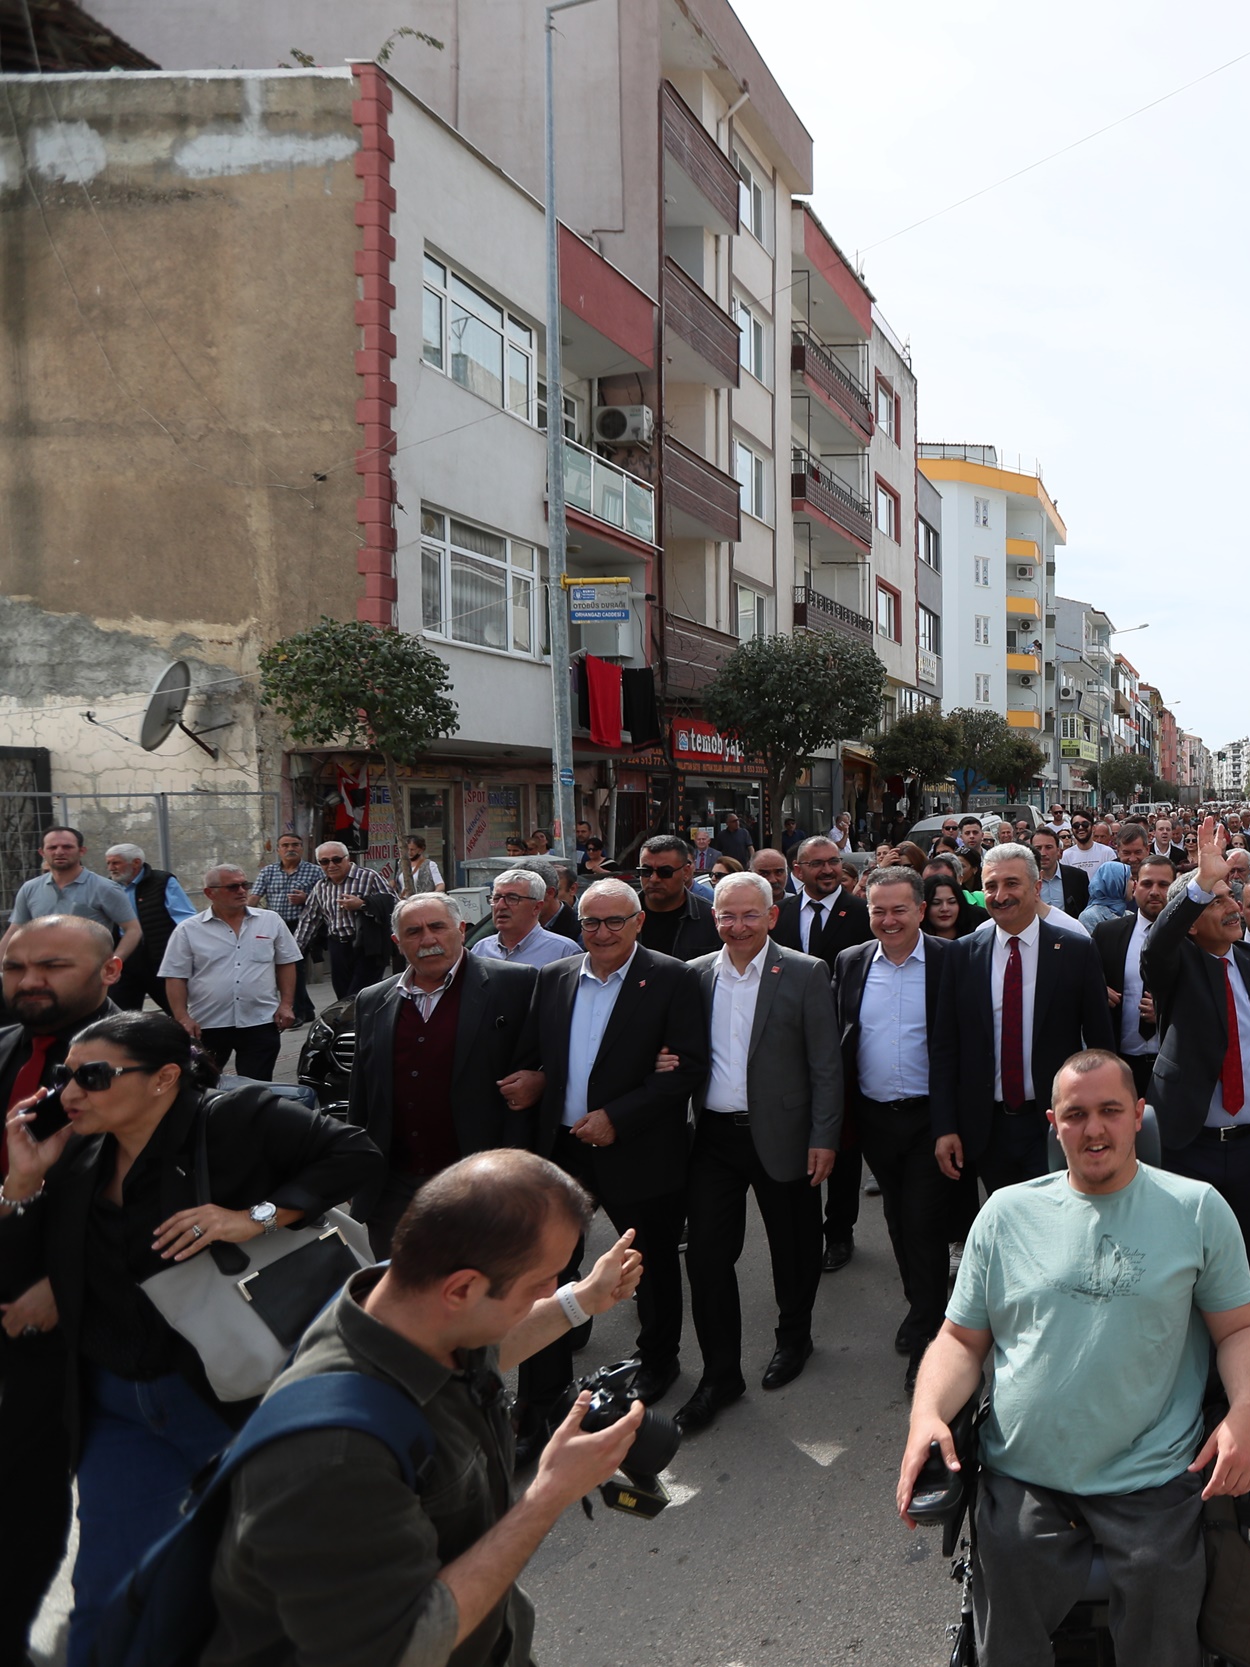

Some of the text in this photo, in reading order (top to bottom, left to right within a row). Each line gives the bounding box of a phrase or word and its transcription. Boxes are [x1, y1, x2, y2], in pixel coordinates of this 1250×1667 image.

[573, 600, 626, 609] OTOBÜS DURAĞI
[690, 728, 723, 755] temob
[467, 791, 486, 803] SPOT
[618, 1491, 637, 1508] Nikon
